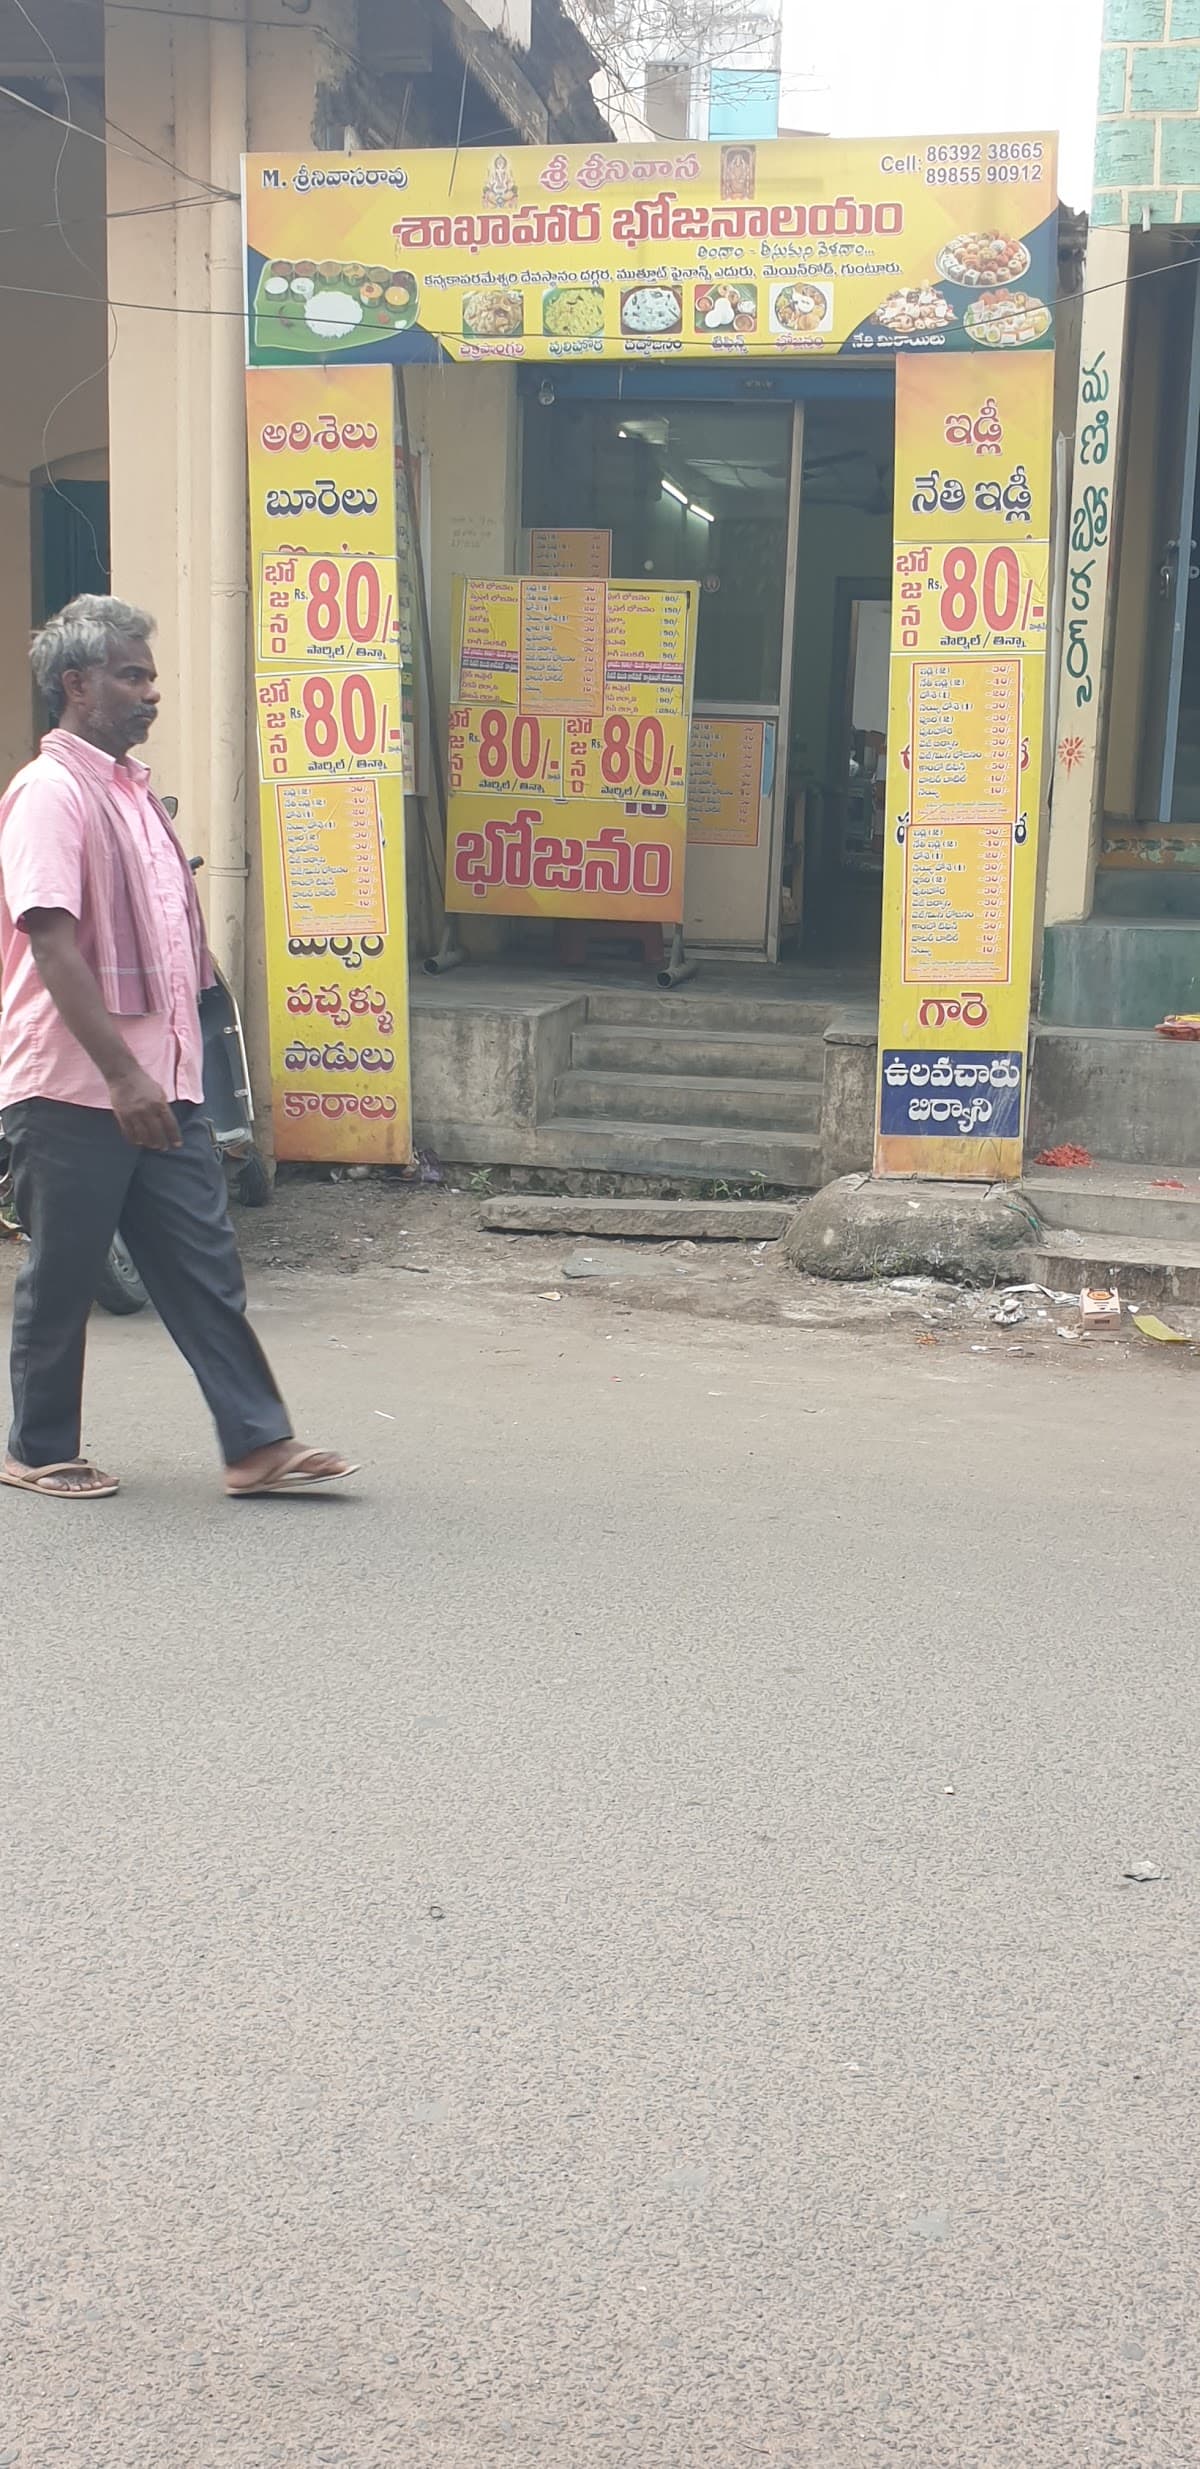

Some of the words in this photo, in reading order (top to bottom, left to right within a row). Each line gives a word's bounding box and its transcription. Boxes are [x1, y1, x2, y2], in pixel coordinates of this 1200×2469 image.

[540, 153, 570, 190] శ్రీ
[576, 152, 700, 191] శ్రీనివాస
[881, 155, 921, 173] Cell:
[926, 146, 982, 162] 86392
[988, 143, 1043, 159] 38665
[263, 169, 286, 187] M.
[293, 166, 407, 191] శ్రీనివాసరావు
[926, 166, 981, 184] 89855
[987, 165, 1041, 182] 90912
[392, 202, 602, 252] శాఖాహార
[612, 192, 904, 249] భోజనాలయం
[520, 271, 577, 288] దేవస్థానం
[262, 415, 378, 451] అరిశెలు
[945, 398, 1003, 455] ఇడ్లీ
[267, 480, 378, 516] బూరెలు
[912, 470, 966, 513] నేతి
[975, 465, 1032, 522] ఇడ్లీ
[295, 589, 308, 600] Rs.
[927, 578, 943, 590] Rs.
[290, 708, 304, 719] Rs.
[468, 733, 480, 743] Rs.
[592, 738, 603, 749] Rs.
[455, 809, 672, 896] భోజనం
[287, 983, 394, 1033] పచ్చళ్ళు
[919, 993, 988, 1027] గారె
[885, 1056, 1020, 1088] ఉలవచారు
[284, 1092, 397, 1119] కారాలు
[908, 1098, 992, 1133] బిర్యాని
